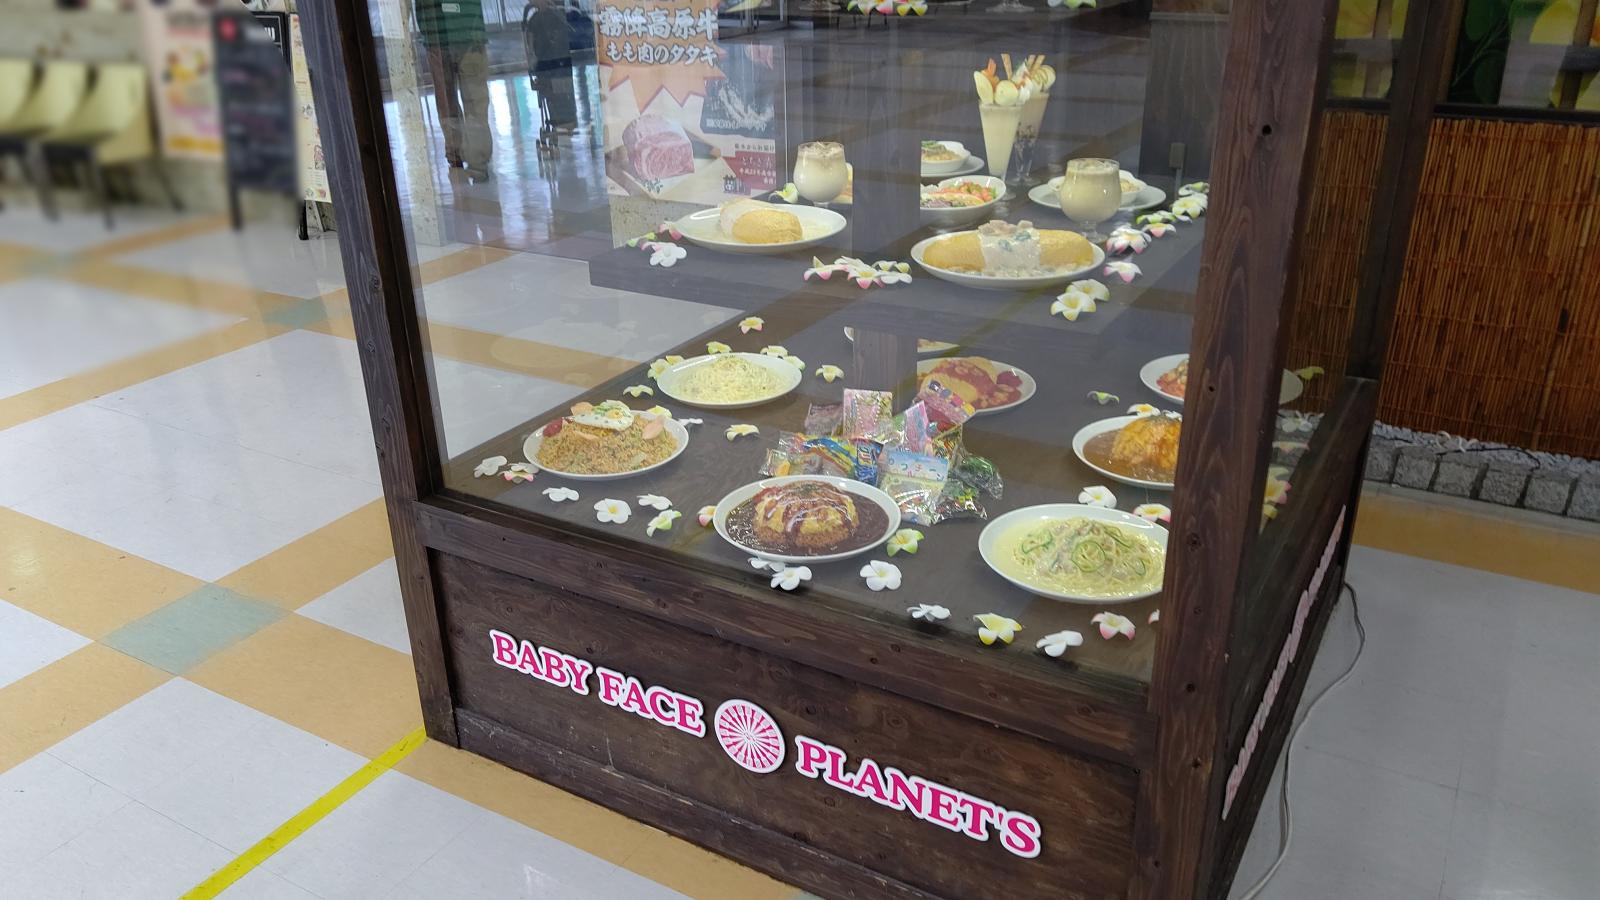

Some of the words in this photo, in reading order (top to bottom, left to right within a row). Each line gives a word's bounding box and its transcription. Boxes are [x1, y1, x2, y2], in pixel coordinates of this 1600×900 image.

[606, 41, 718, 66] もも肉のタタキ
[491, 632, 590, 692] BABY
[599, 670, 703, 734] FACE
[799, 739, 1037, 854] PLANET'S
